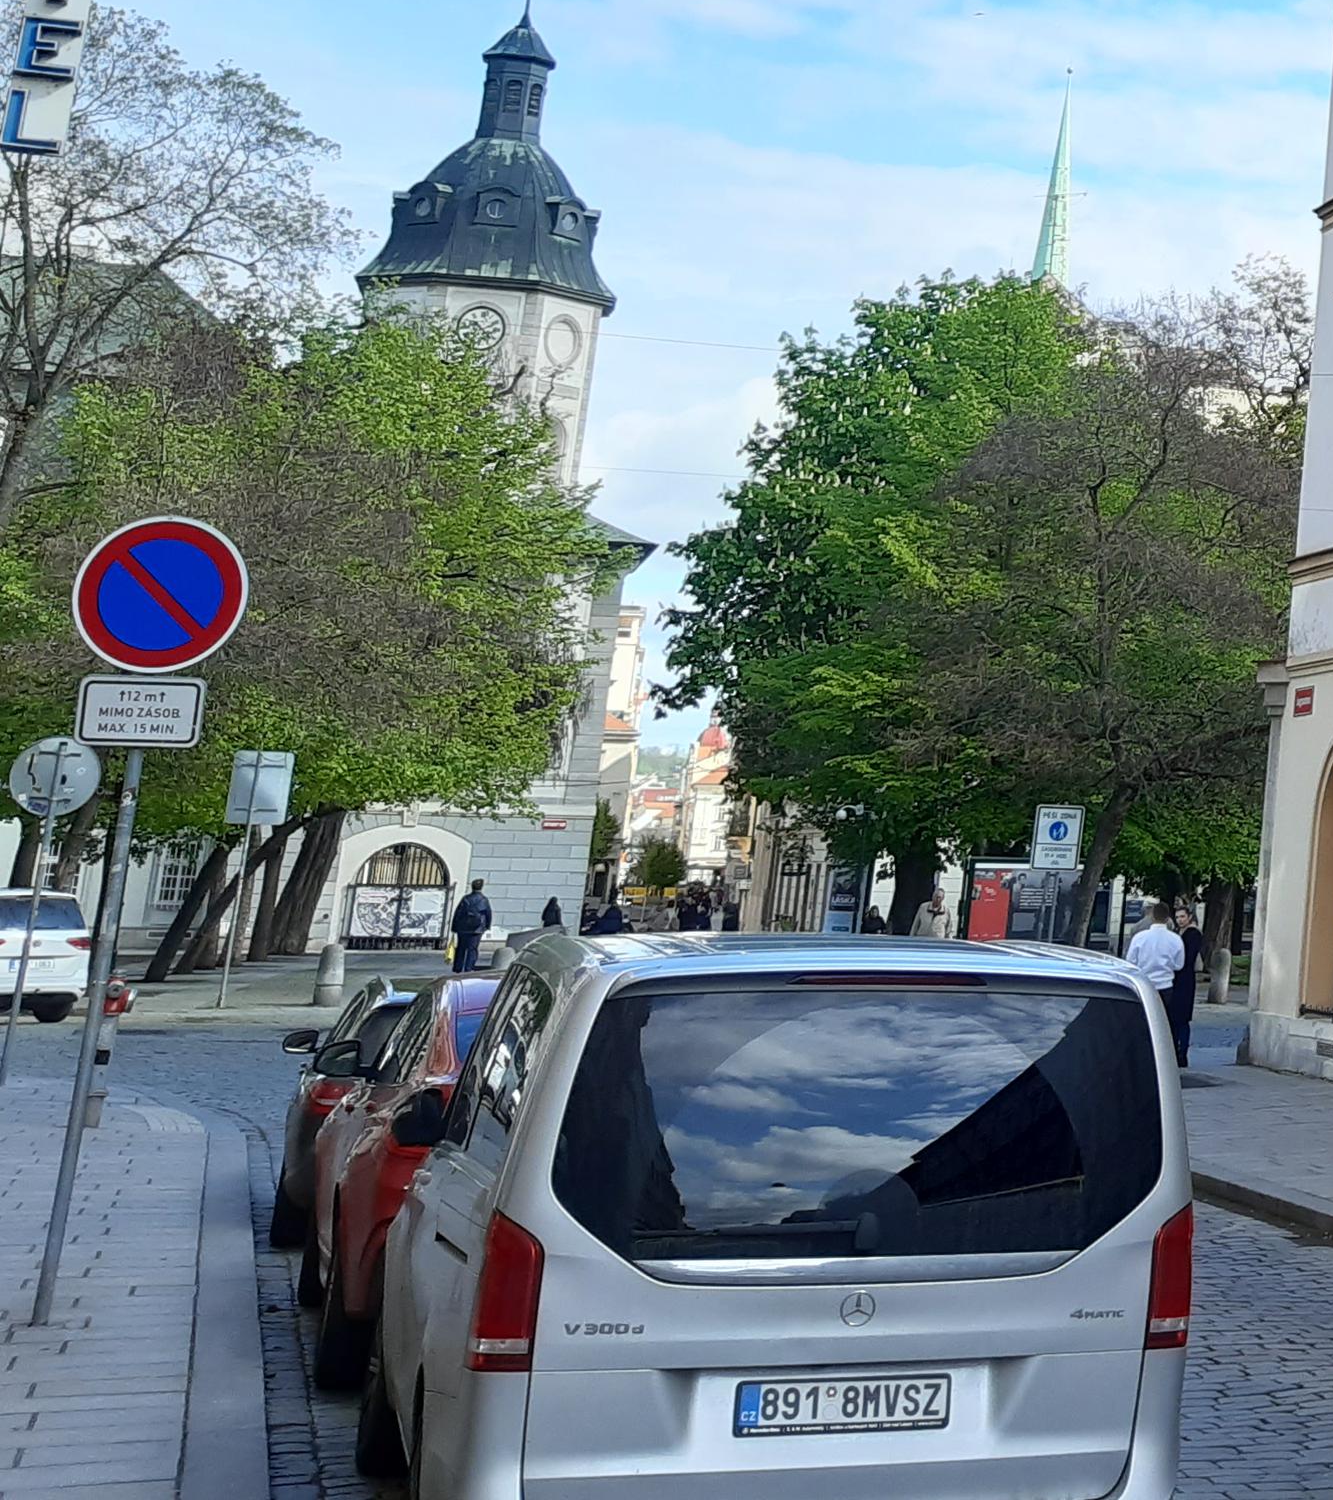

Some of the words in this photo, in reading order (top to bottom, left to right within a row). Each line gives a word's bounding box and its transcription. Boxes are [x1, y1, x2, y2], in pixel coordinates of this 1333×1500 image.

[127, 691, 141, 702] 12
[144, 693, 157, 702] m
[98, 707, 134, 718] MIMO
[97, 723, 128, 733] MAX.
[134, 723, 146, 733] 15
[149, 724, 178, 735] MIN.
[1069, 1308, 1125, 1320] 4MATIC
[740, 1411, 757, 1422] CZ
[761, 1386, 820, 1421] 891
[841, 1383, 942, 1419] 8MVSZ
